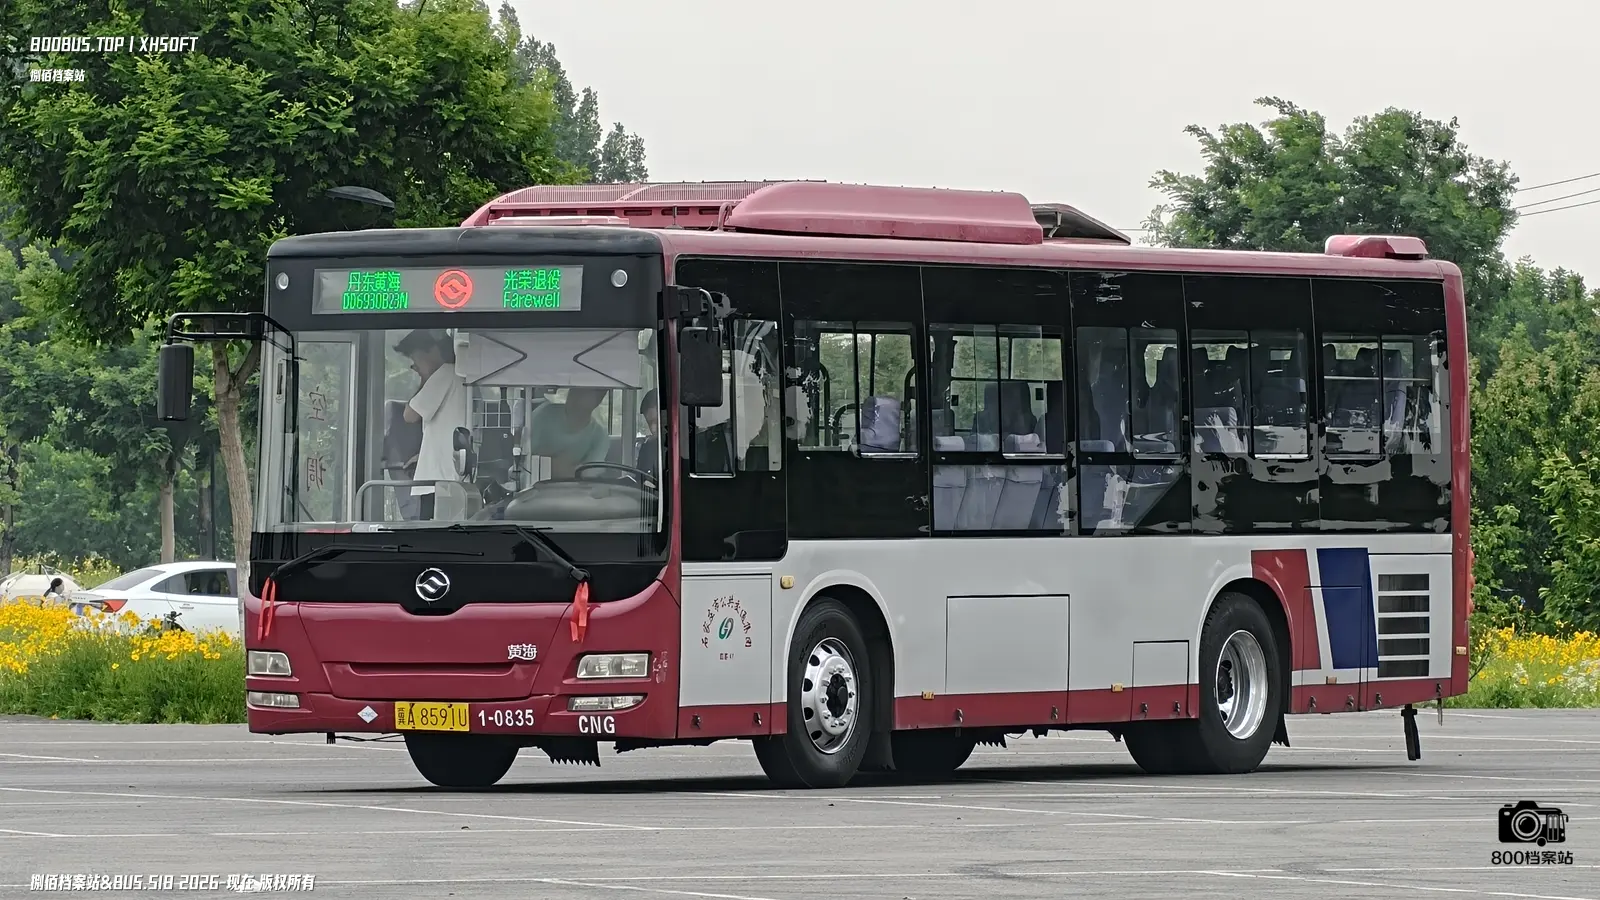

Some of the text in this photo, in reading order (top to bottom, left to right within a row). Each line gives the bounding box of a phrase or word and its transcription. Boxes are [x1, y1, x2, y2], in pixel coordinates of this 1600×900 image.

[347, 271, 401, 292] 丹东黄海
[503, 269, 561, 290] 光荣退役
[503, 291, 560, 308] Farewell
[507, 643, 538, 661] 黄海
[478, 709, 534, 727] 1-0835
[578, 715, 616, 734] CNG
